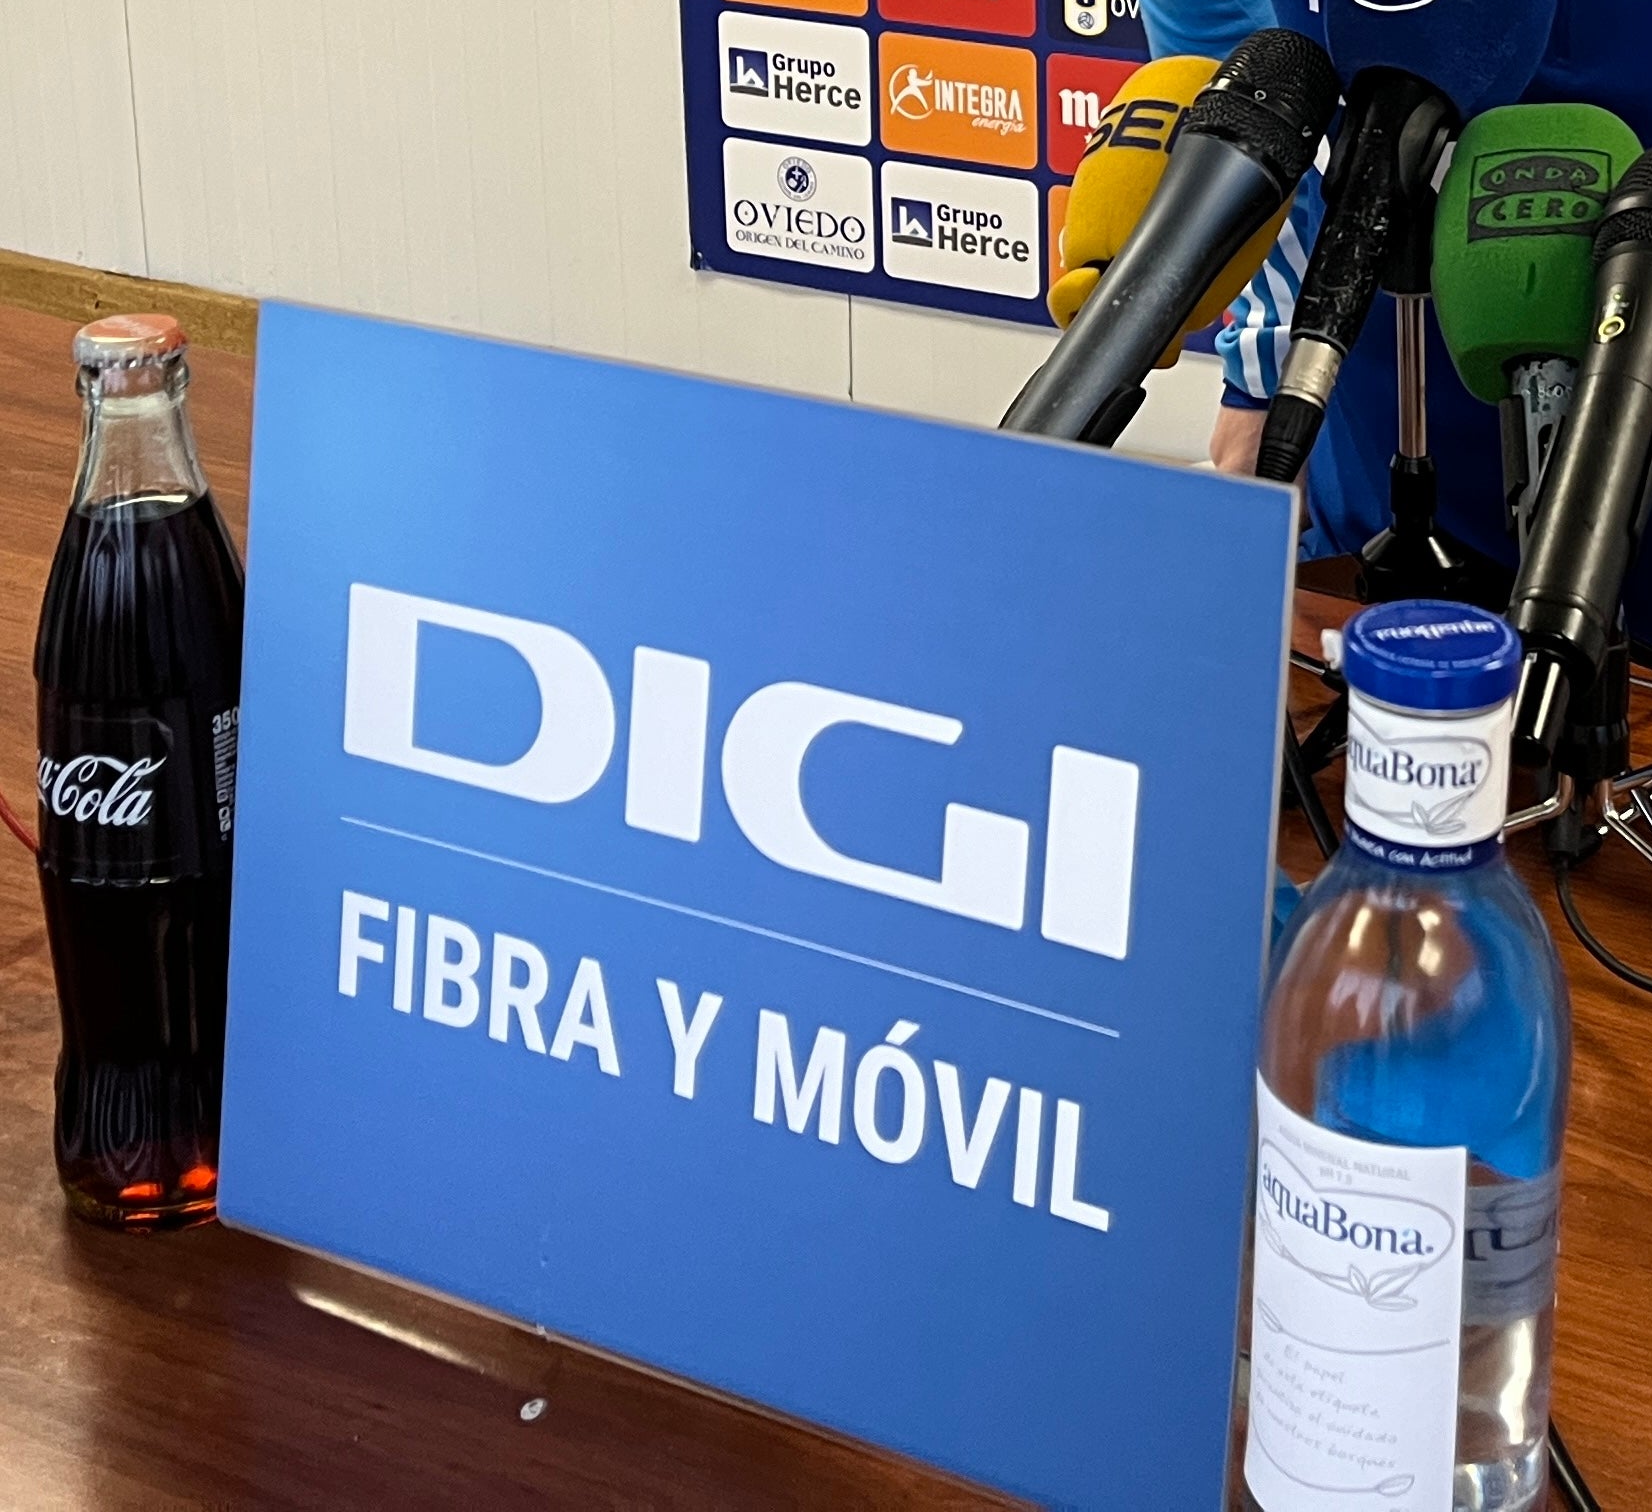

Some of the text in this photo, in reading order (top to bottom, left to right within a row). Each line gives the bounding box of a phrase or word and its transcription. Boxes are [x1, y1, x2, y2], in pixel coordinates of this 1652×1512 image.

[773, 54, 835, 79] Grupo
[774, 75, 861, 109] Herce
[935, 79, 1022, 121] INTEGRA
[1491, 167, 1587, 185] ONDA
[734, 200, 865, 247] OVIEDO
[937, 204, 1002, 231] Grupo
[1492, 196, 1589, 222] CERO
[736, 230, 864, 259] ORIGEN DEL CAMINO
[939, 226, 1029, 262] Herce
[340, 582, 1139, 965] DIGI
[339, 891, 1109, 1231] FIBRA Y MÓVIL
